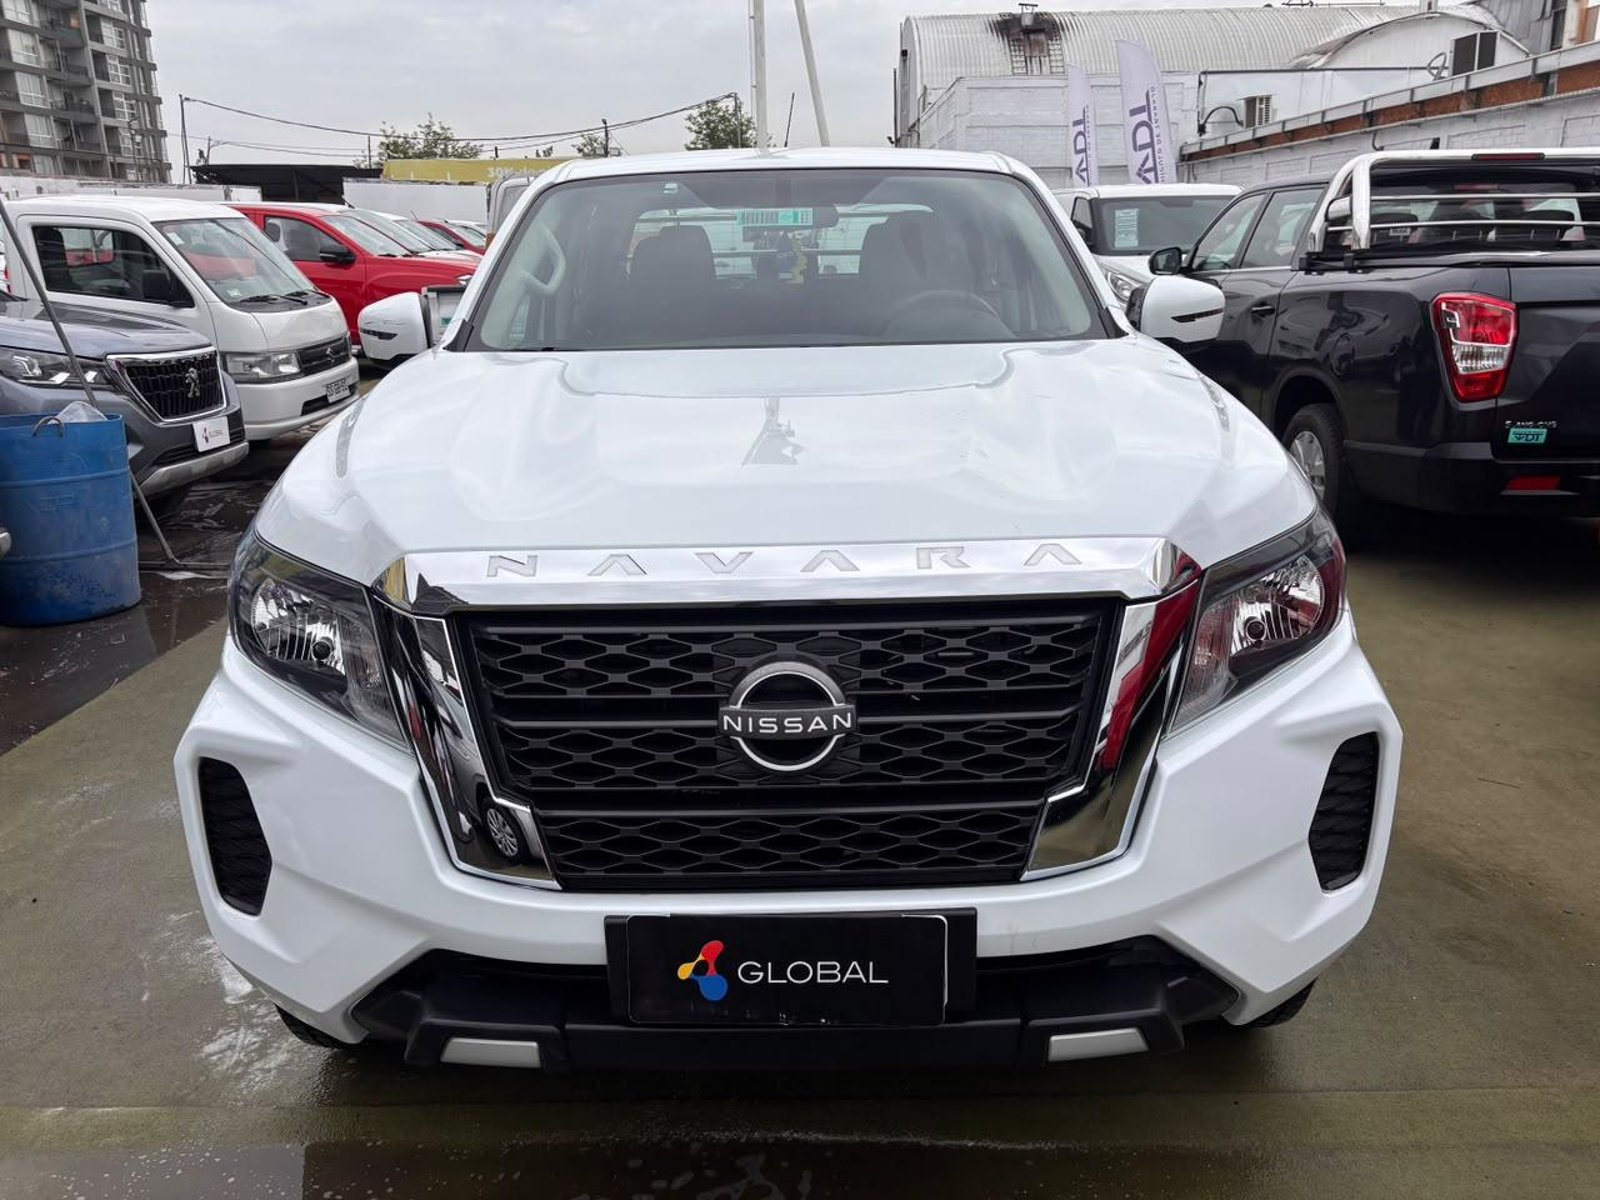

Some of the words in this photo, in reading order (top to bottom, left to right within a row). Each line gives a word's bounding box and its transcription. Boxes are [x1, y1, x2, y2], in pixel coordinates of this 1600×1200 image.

[486, 542, 1083, 578] NAVARA
[723, 712, 852, 734] NISSAN
[738, 960, 890, 985] GLOBAL
